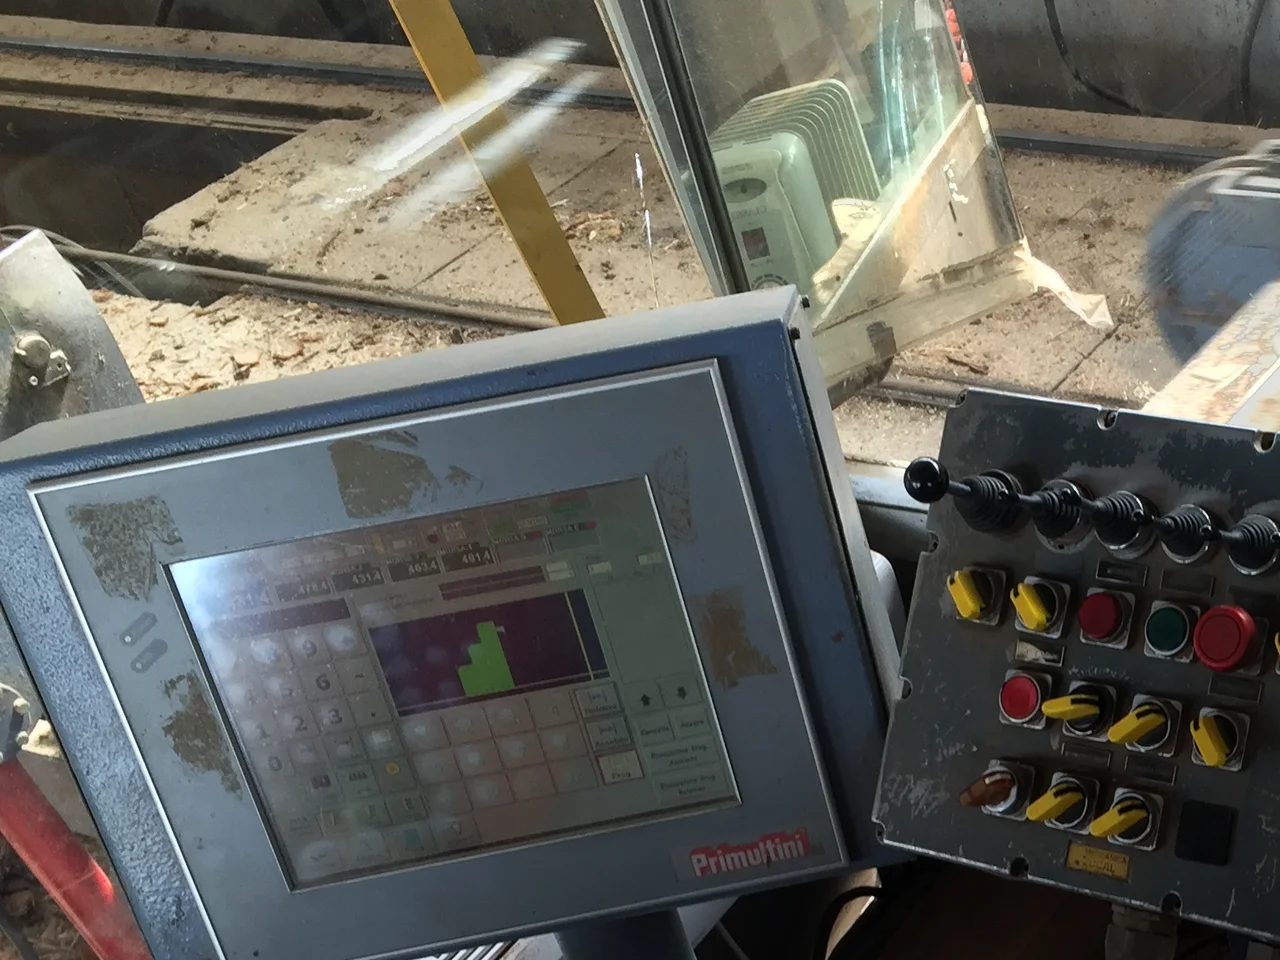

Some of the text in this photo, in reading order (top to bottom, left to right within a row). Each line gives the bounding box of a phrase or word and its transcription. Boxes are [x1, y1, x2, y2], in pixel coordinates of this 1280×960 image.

[315, 673, 331, 691] 6
[292, 715, 308, 732] 2
[328, 708, 343, 725] 3
[690, 833, 806, 877] Primultini
